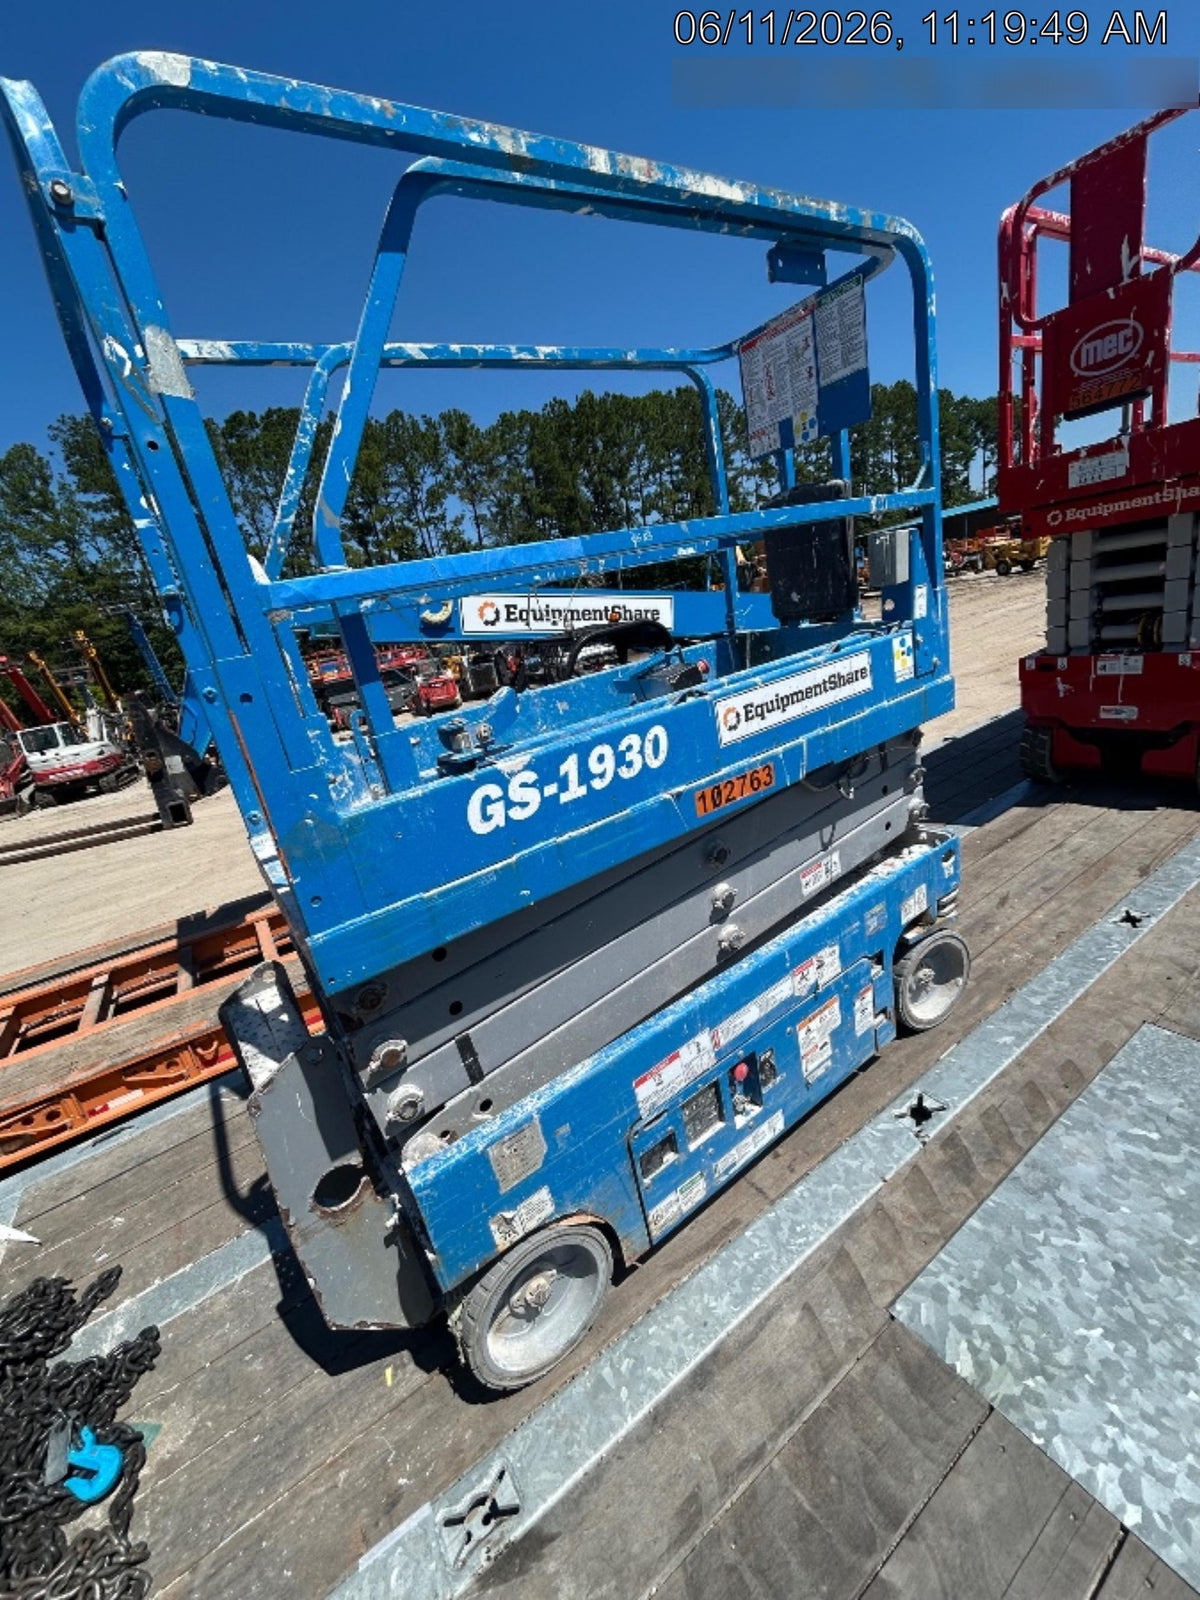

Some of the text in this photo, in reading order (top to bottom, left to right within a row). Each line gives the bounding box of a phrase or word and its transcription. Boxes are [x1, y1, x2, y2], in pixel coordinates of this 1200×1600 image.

[504, 603, 660, 626] EquipmentShare
[743, 666, 868, 723] EquipmentShare
[467, 725, 669, 835] GS-1930
[698, 764, 773, 813] 102763
